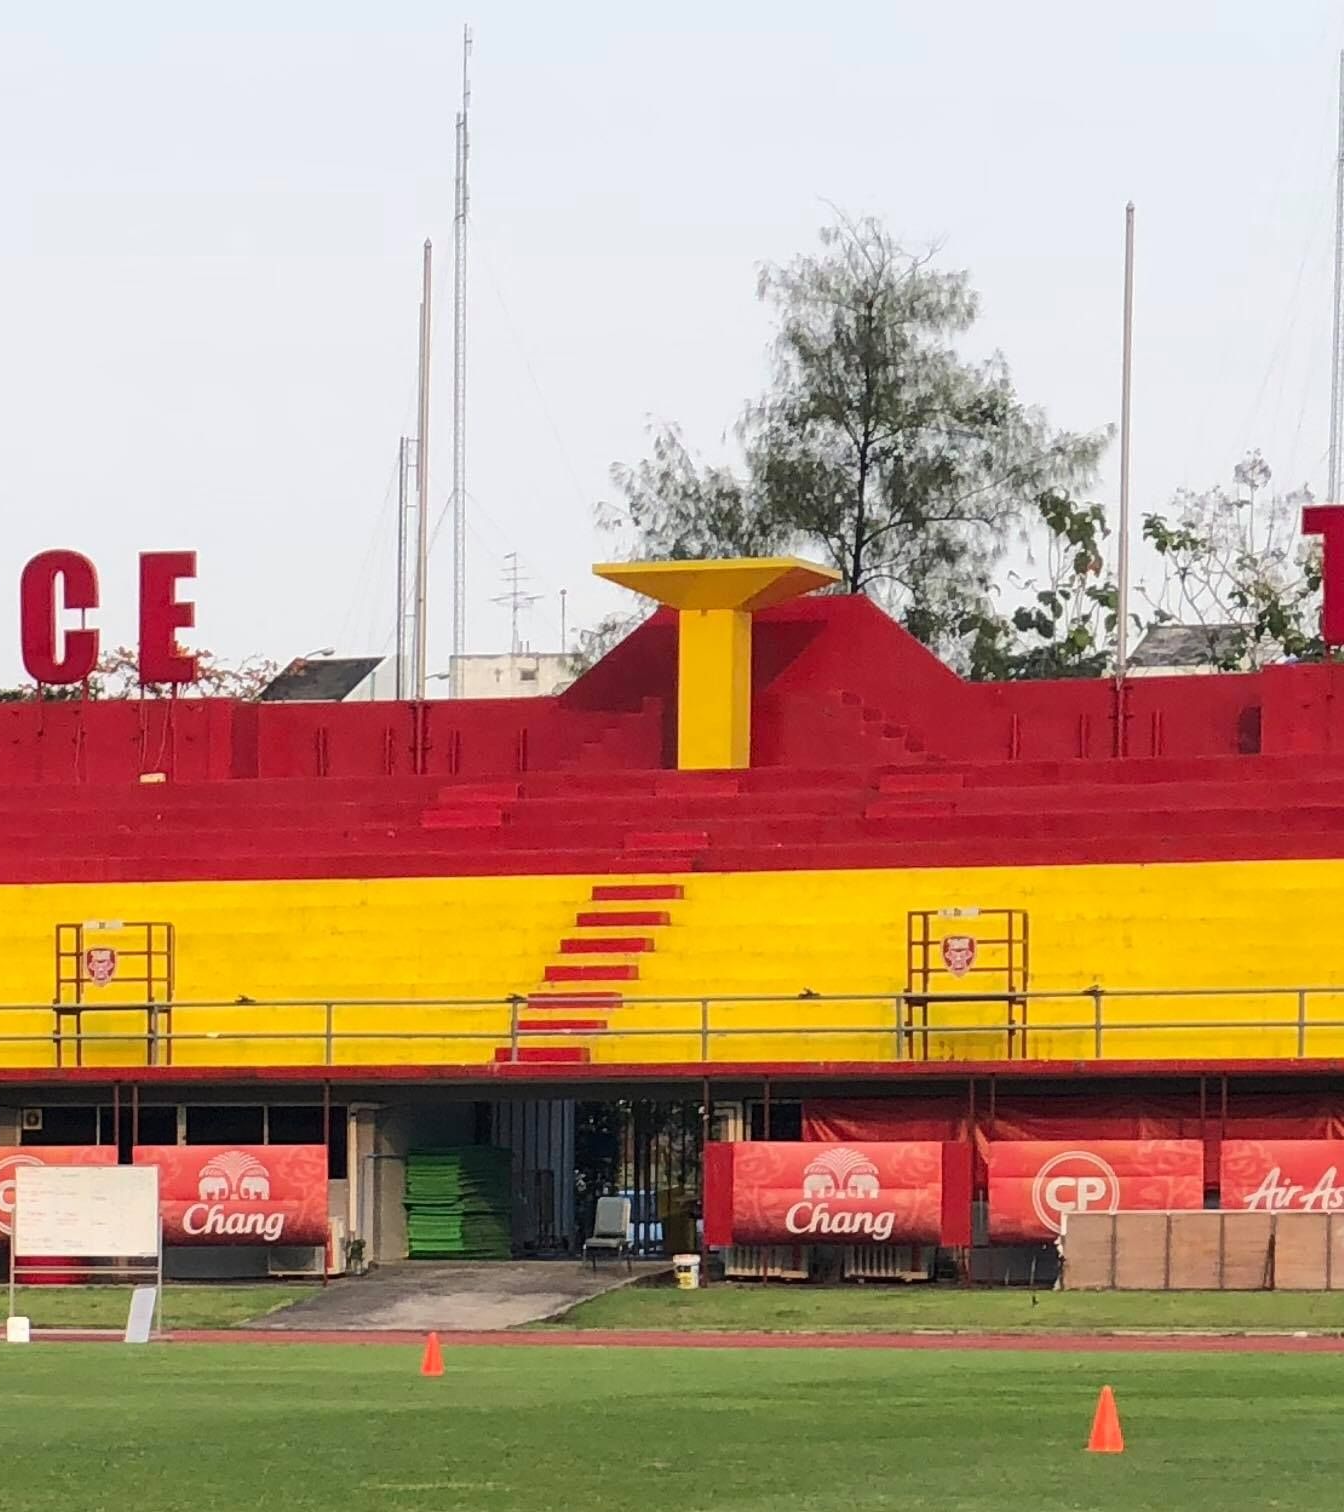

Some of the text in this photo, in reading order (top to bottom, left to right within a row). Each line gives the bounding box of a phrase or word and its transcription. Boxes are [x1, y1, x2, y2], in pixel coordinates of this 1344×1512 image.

[1046, 1177, 1106, 1210] CP
[182, 1203, 285, 1241] Chang
[785, 1200, 896, 1241] Chang
